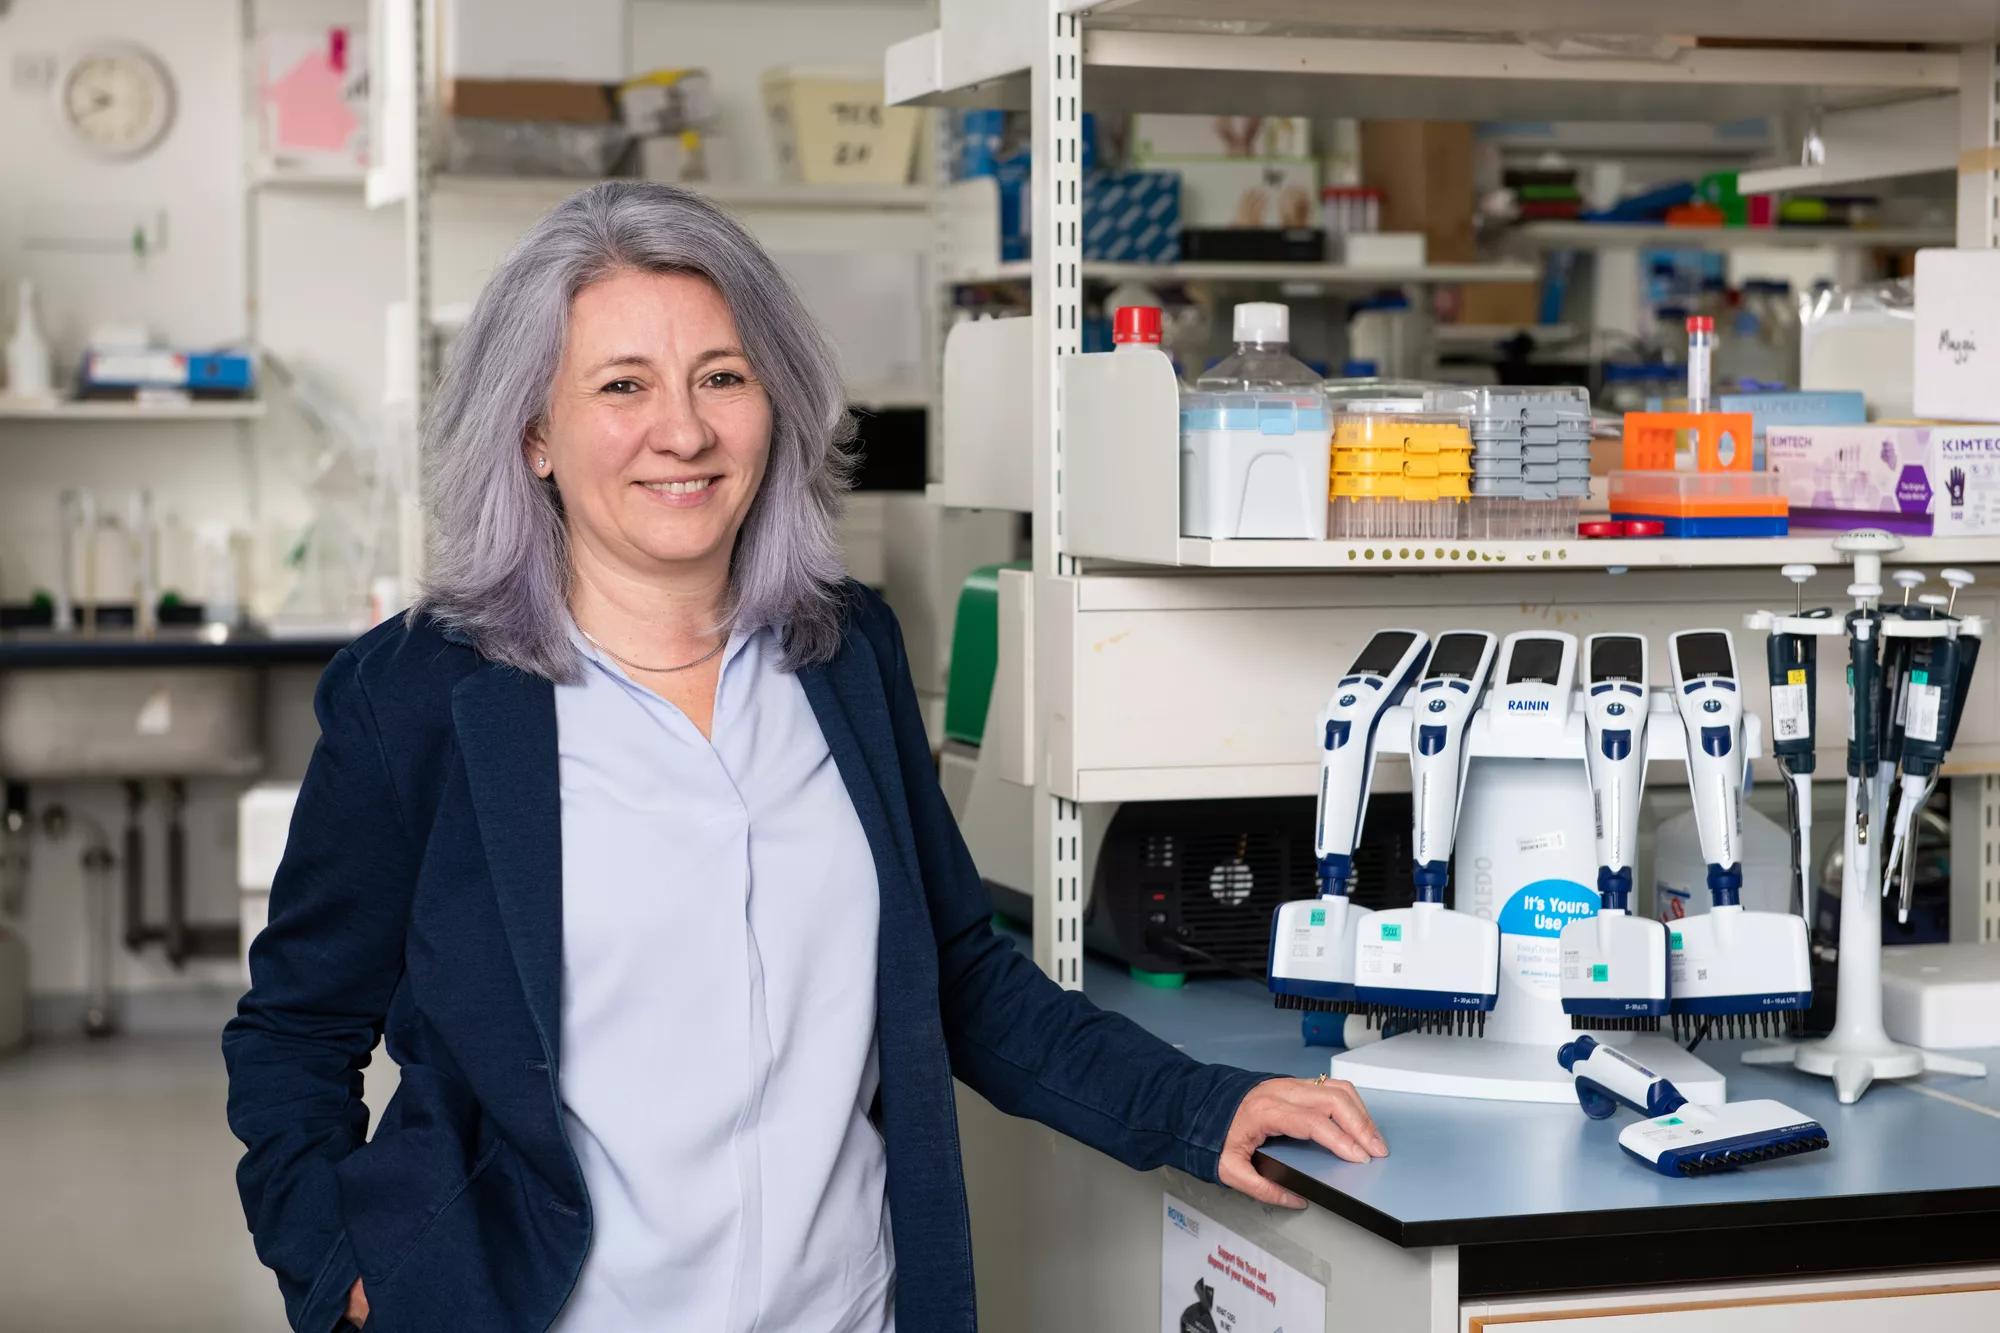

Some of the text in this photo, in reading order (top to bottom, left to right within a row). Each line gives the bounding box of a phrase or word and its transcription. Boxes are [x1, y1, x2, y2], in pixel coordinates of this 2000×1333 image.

[1771, 436, 1812, 448] KIMTECH
[1508, 700, 1549, 711] RAININ
[1524, 896, 1594, 915] It's Yours.
[1535, 915, 1562, 931] Use
